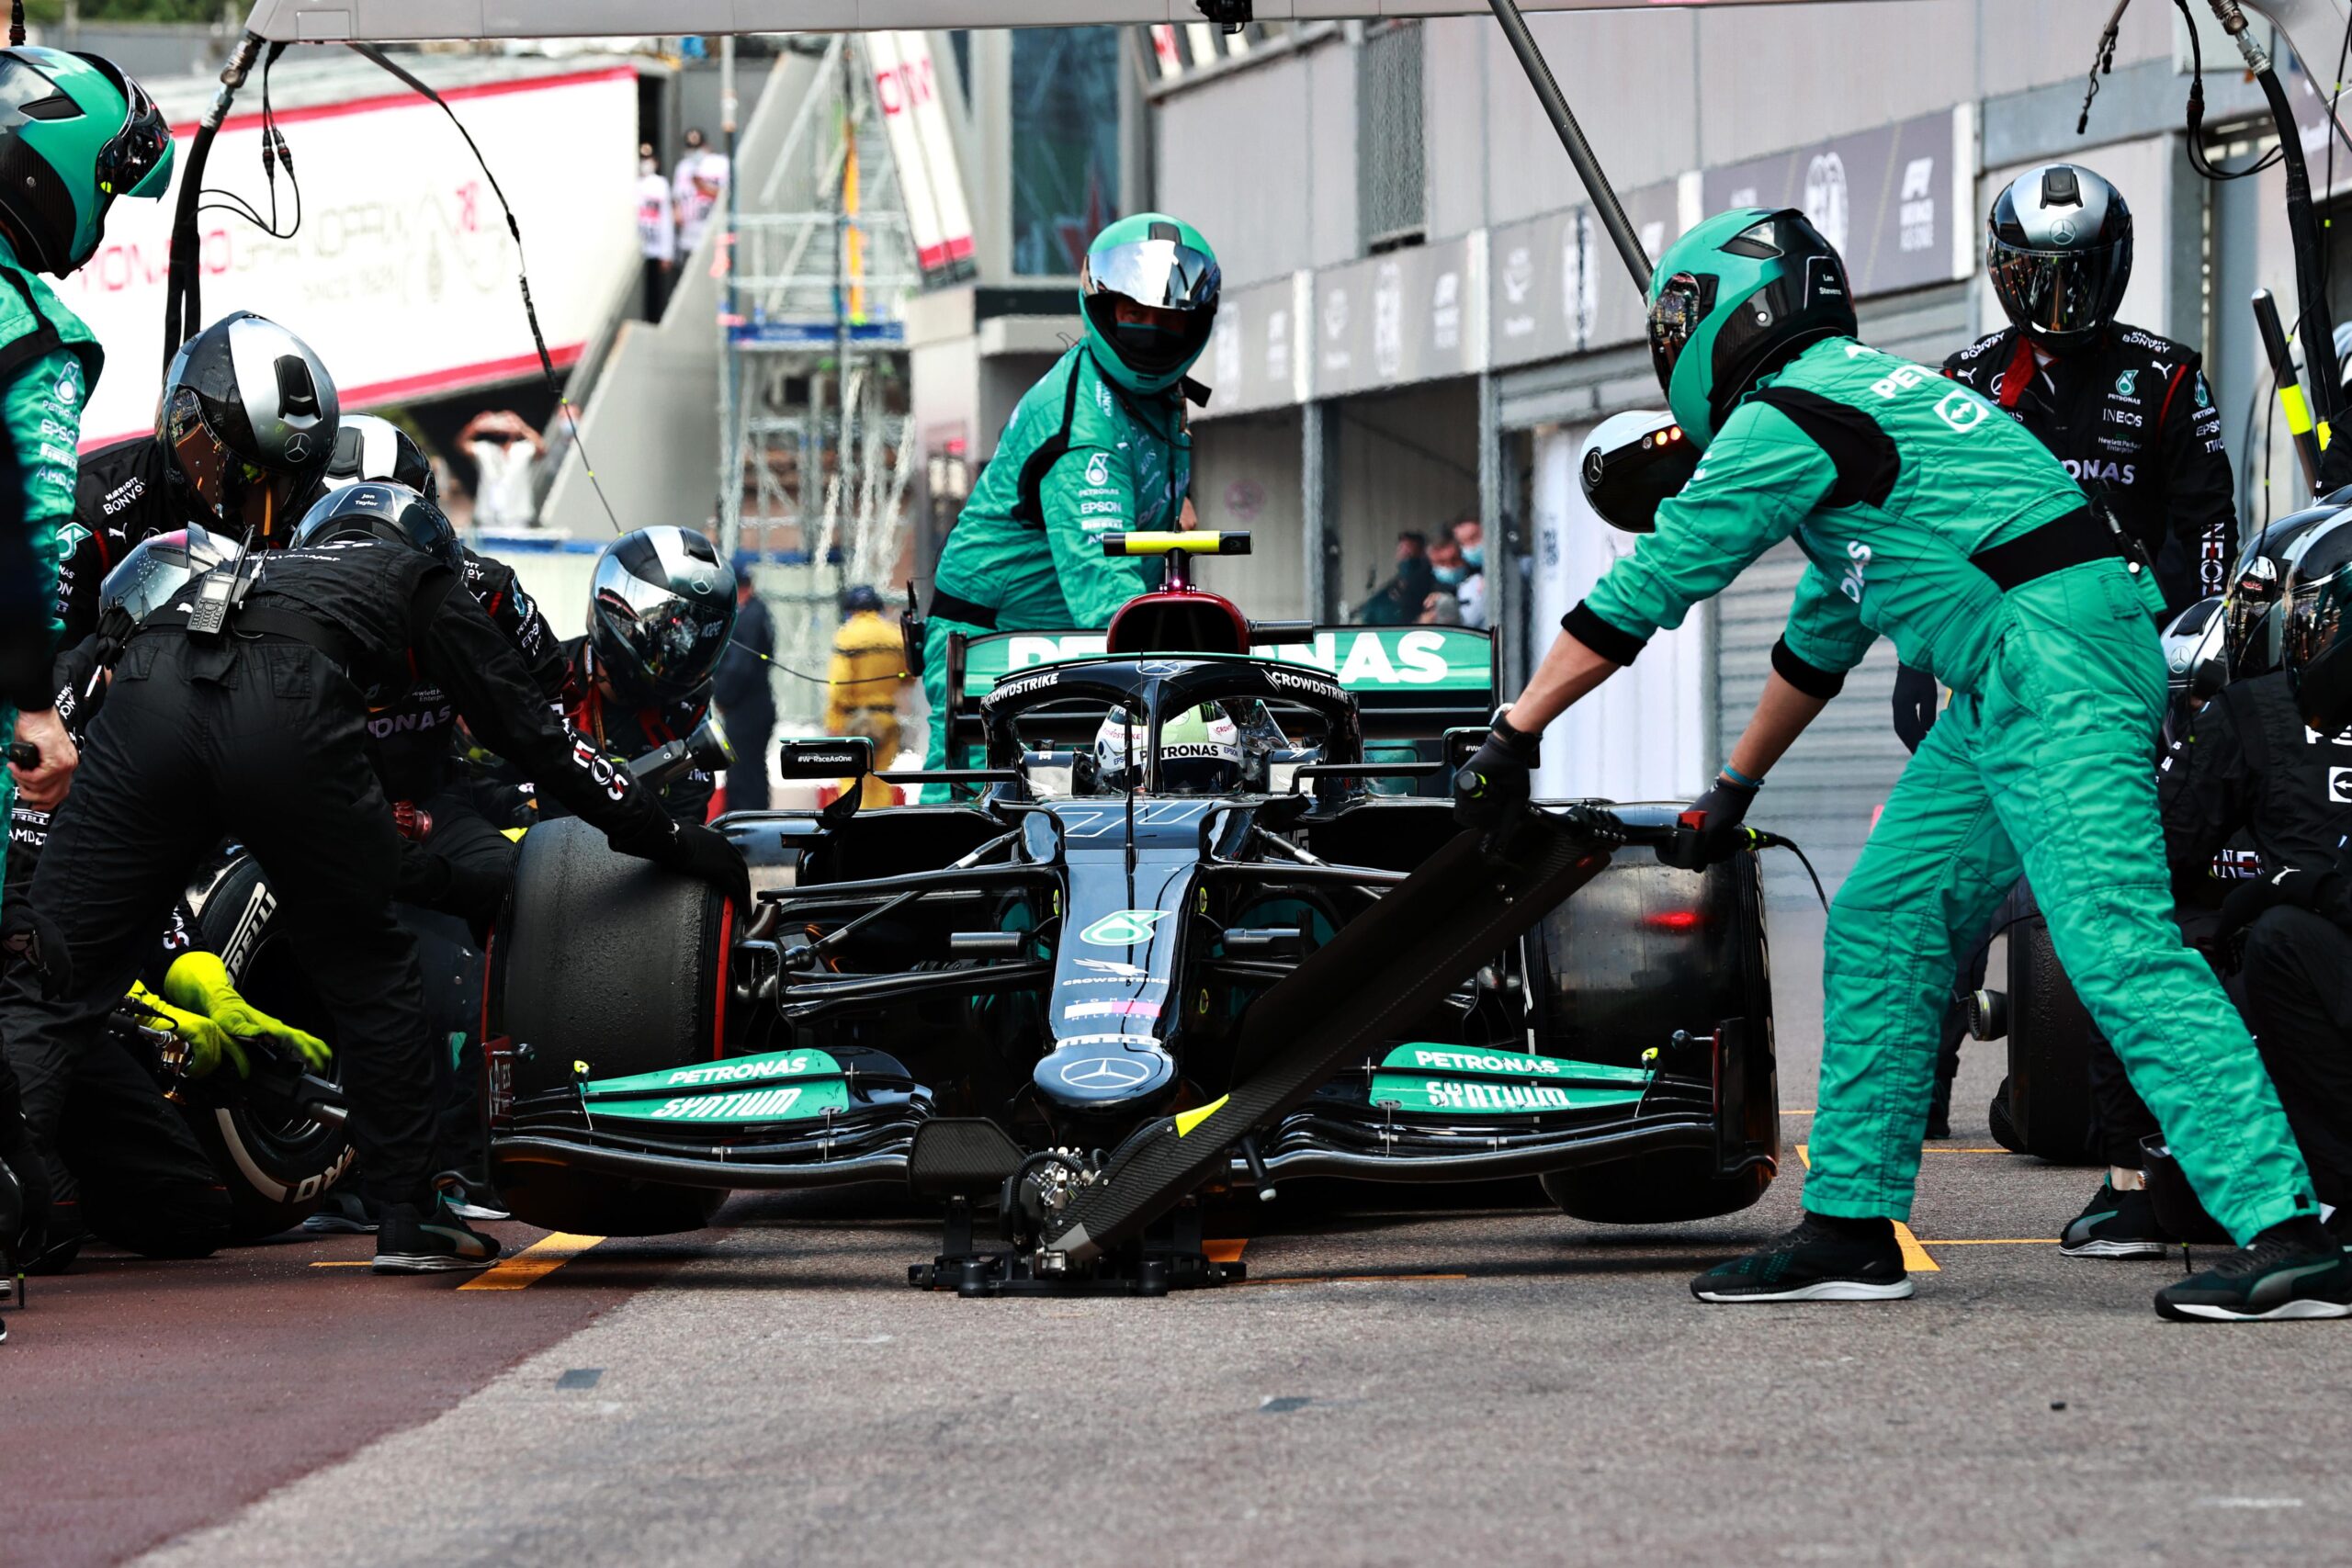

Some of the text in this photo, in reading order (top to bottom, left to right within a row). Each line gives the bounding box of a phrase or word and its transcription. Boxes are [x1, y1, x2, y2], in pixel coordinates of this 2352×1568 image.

[2122, 333, 2171, 354] BONVOY
[2108, 393, 2142, 405] PETRONAS
[2102, 409, 2143, 428] INEOS
[2098, 435, 2122, 447] Hewlett
[105, 477, 139, 502] MARRIOTT
[1080, 502, 1122, 514] EPSON
[1088, 534, 1103, 546] AM
[985, 672, 1060, 705] CROWDSTRIKE
[1272, 671, 1349, 704] CROWDSTRIKE
[1140, 745, 1219, 761] PTRONAS
[1223, 746, 1238, 758] EPSON
[1062, 976, 1170, 987] CROWDSTRIKE
[1073, 997, 1154, 1005] TOMMY
[667, 1056, 808, 1085] PETRONAS
[1415, 1050, 1560, 1074] PETRONAS
[650, 1088, 802, 1118] SYNTIUM
[1426, 1081, 1571, 1109] SYNTIUM
